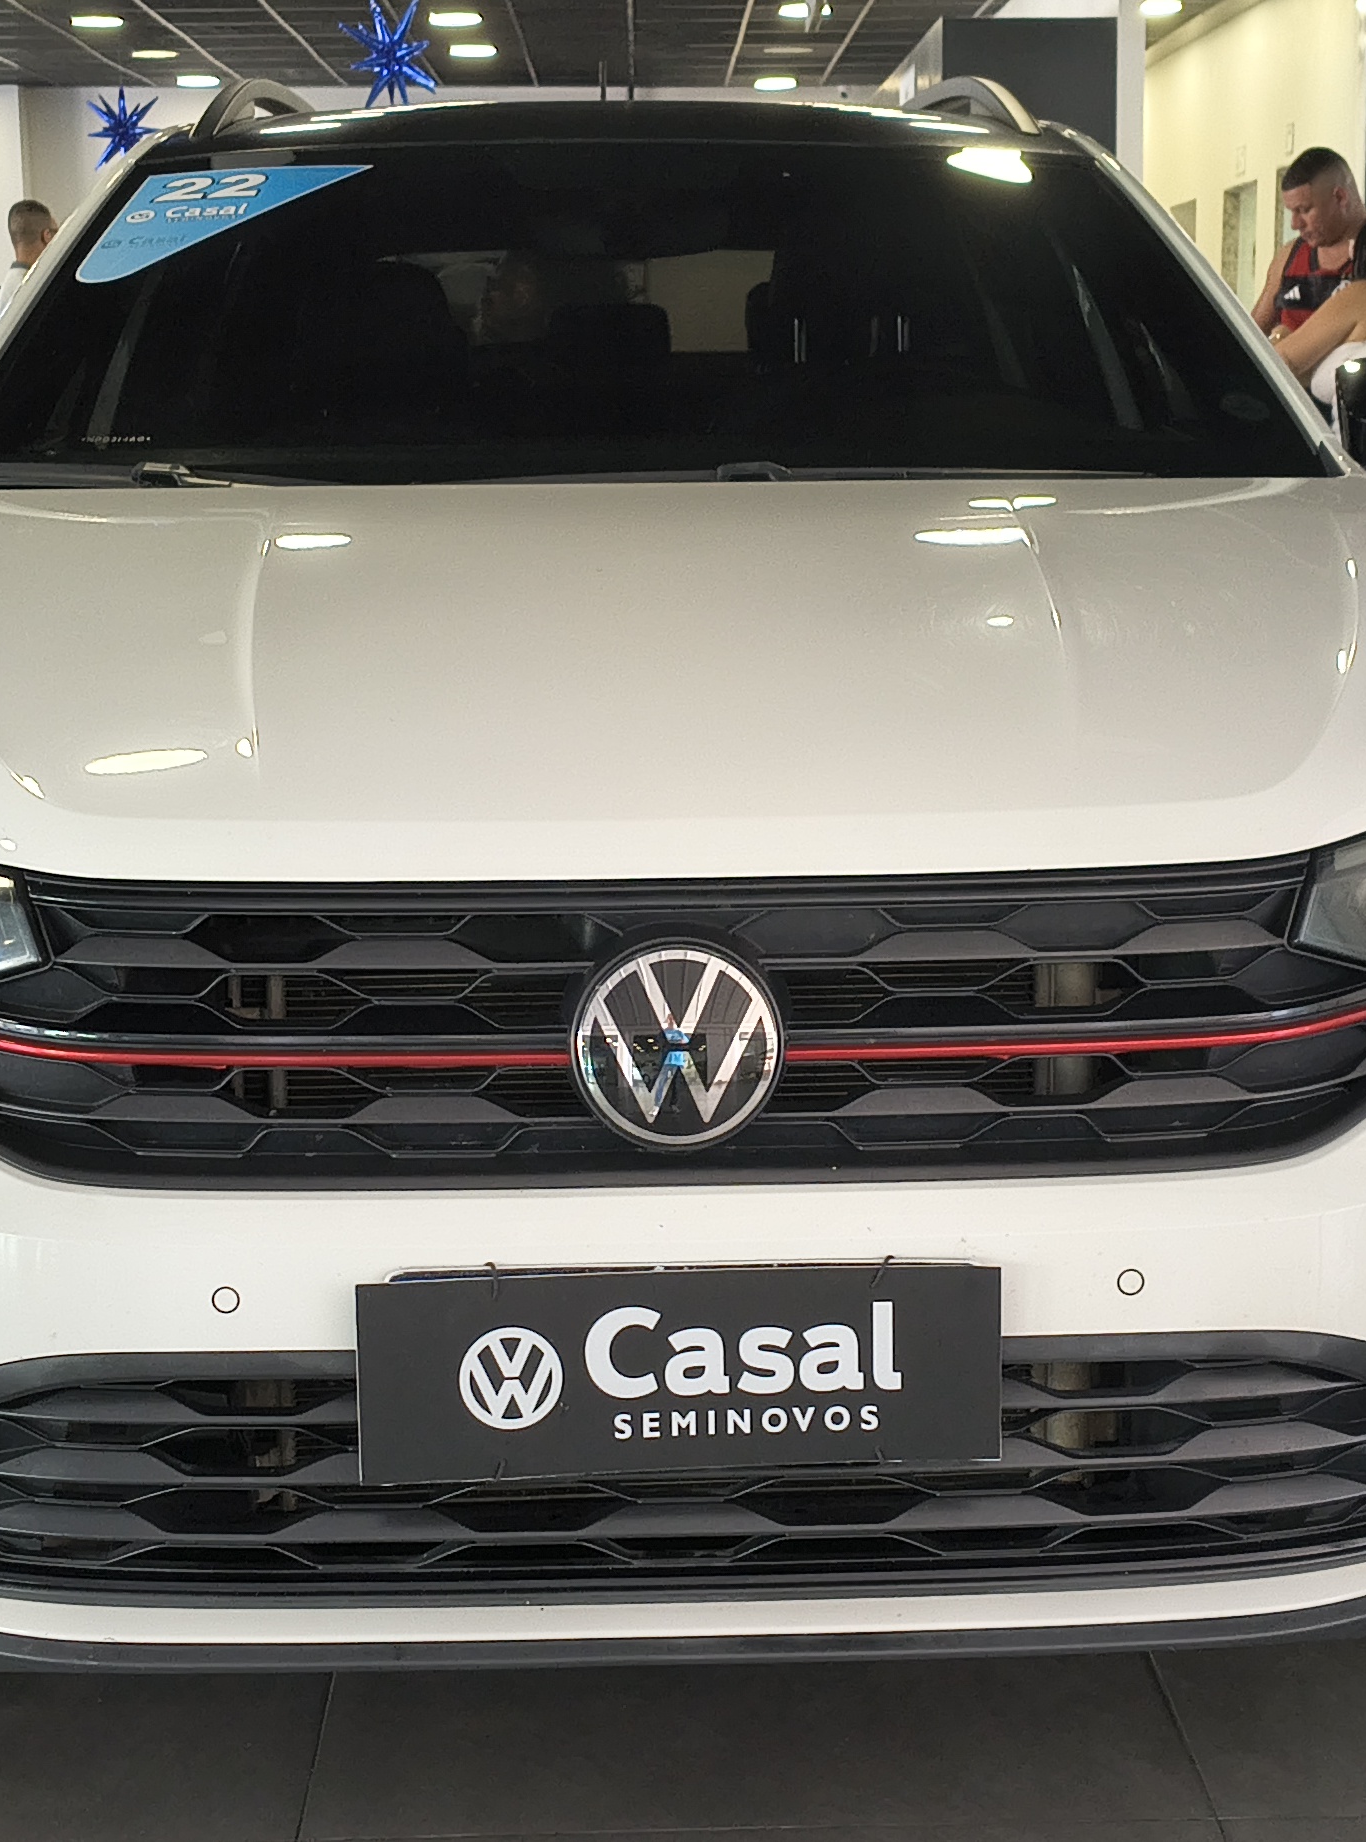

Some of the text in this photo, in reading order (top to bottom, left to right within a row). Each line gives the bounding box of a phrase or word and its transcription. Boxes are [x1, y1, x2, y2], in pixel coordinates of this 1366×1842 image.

[151, 173, 268, 203] 22
[166, 203, 248, 218] Casal
[584, 1301, 903, 1399] Casal
[614, 1404, 881, 1440] SEMINOVOS
